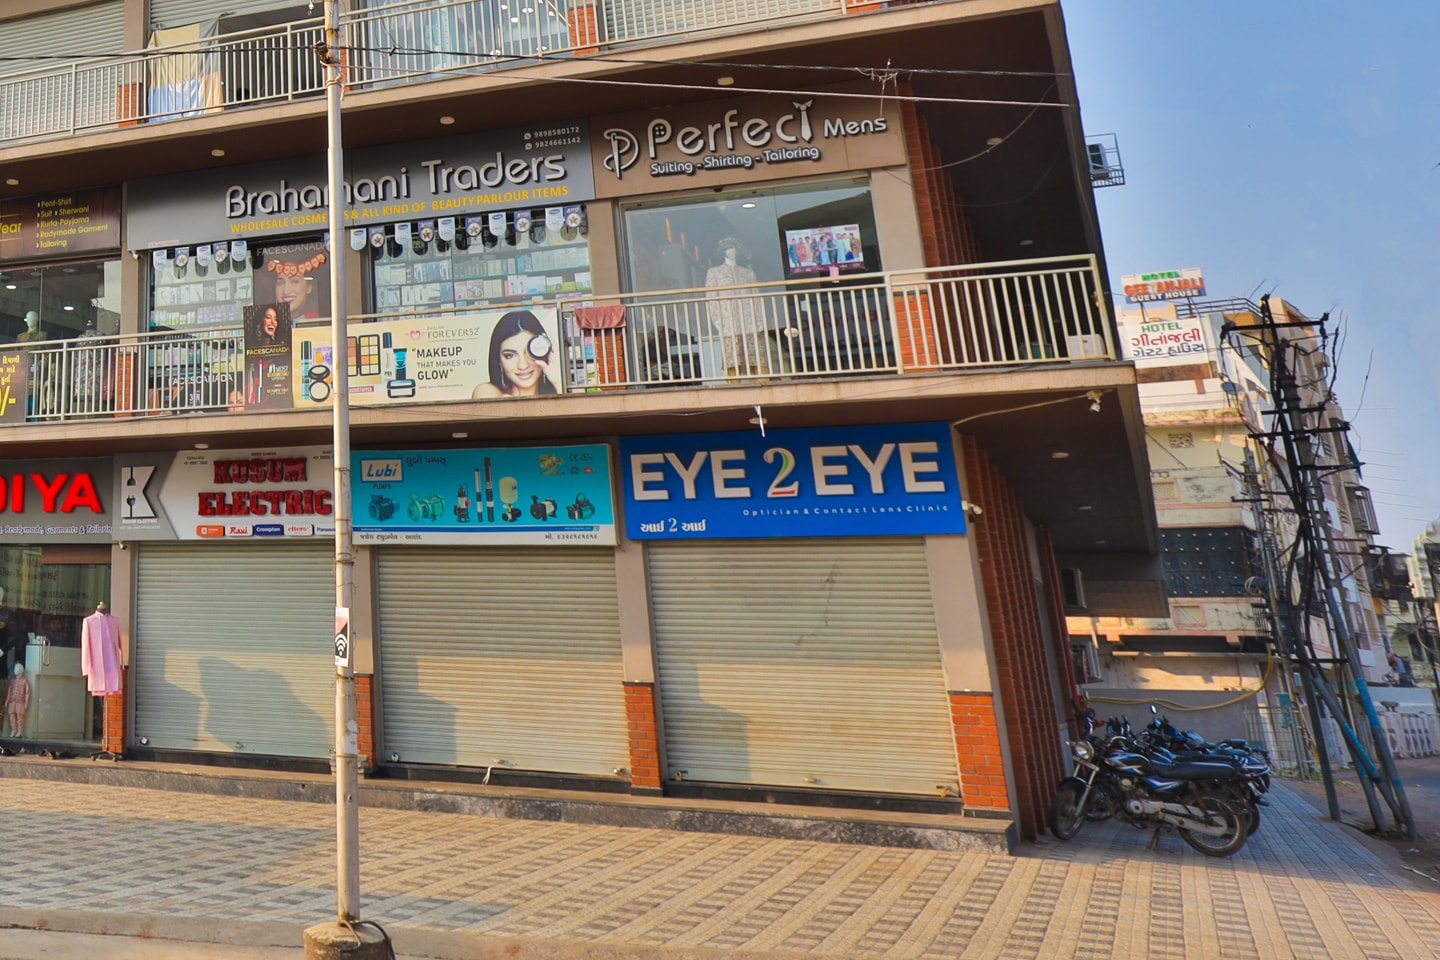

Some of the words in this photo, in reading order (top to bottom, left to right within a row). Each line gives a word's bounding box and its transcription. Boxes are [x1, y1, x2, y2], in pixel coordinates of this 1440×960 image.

[824, 117, 888, 138] Mens
[650, 161, 694, 176] Suiting
[704, 154, 753, 169] Shirting
[763, 147, 821, 162] Tailoring
[421, 151, 566, 196] Traders
[230, 218, 289, 233] WHOLESALE
[350, 208, 359, 219] &
[362, 205, 380, 219] ALL
[383, 202, 410, 216] KIND
[412, 200, 427, 213] OF
[431, 195, 475, 210] BEAUTY
[477, 189, 529, 206] PARLOUR
[532, 185, 569, 199] ITEMS
[1142, 271, 1181, 281] HOTEL
[1131, 294, 1162, 302] GUEST
[1166, 290, 1199, 298] HOUSE
[1142, 322, 1182, 333] HOTEL
[213, 457, 308, 484] KUSUM
[367, 463, 399, 477] Lubi
[631, 450, 751, 501] EYE
[763, 447, 799, 498] 2
[811, 441, 946, 496] EYE
[198, 490, 334, 516] ELECTRIC
[743, 507, 799, 517] Optician
[814, 506, 868, 515] Contact
[871, 504, 902, 514] Lens
[906, 504, 949, 513] Clinic
[668, 518, 678, 532] 2
